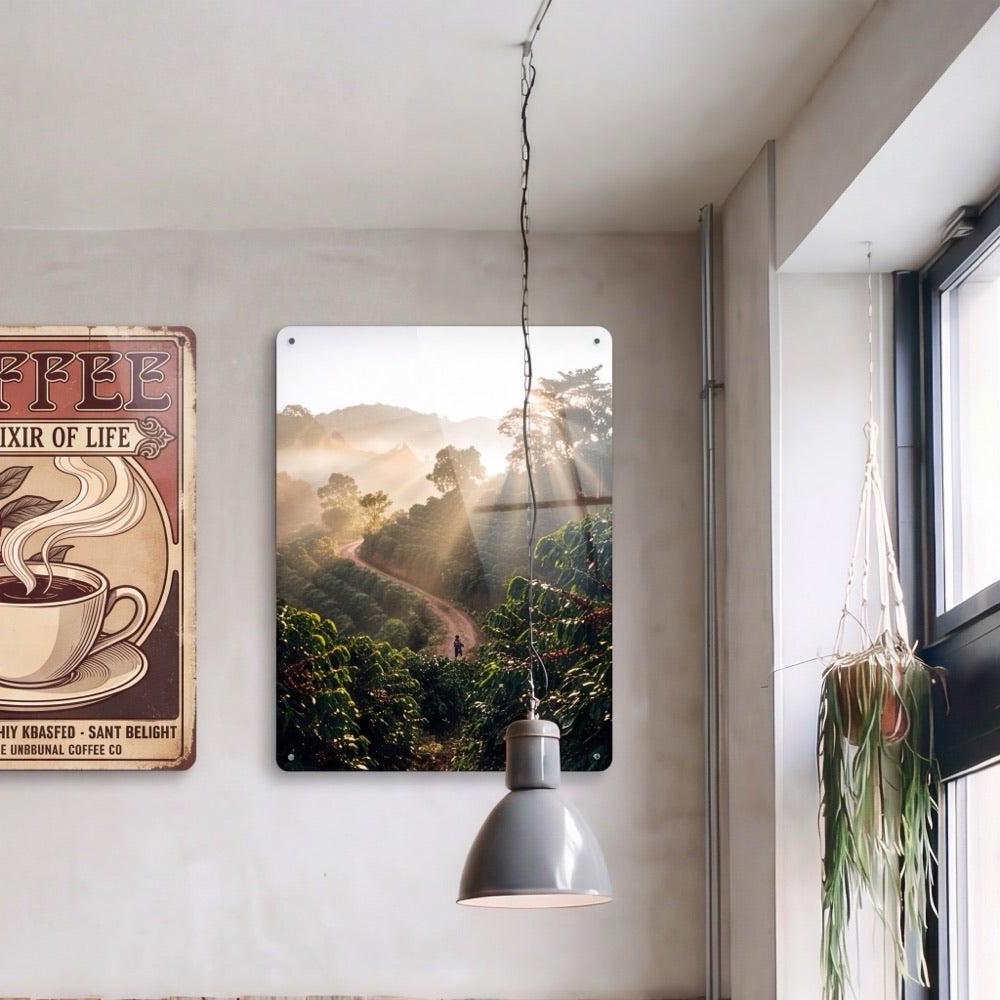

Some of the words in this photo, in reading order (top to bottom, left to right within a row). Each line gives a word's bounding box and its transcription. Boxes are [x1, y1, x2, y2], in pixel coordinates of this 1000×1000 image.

[52, 426, 79, 448] OF
[86, 426, 131, 448] LIFE
[88, 725, 122, 739] SANT
[125, 725, 178, 739] BELIGHT
[68, 744, 105, 756] COFFEE
[108, 744, 122, 756] CO
